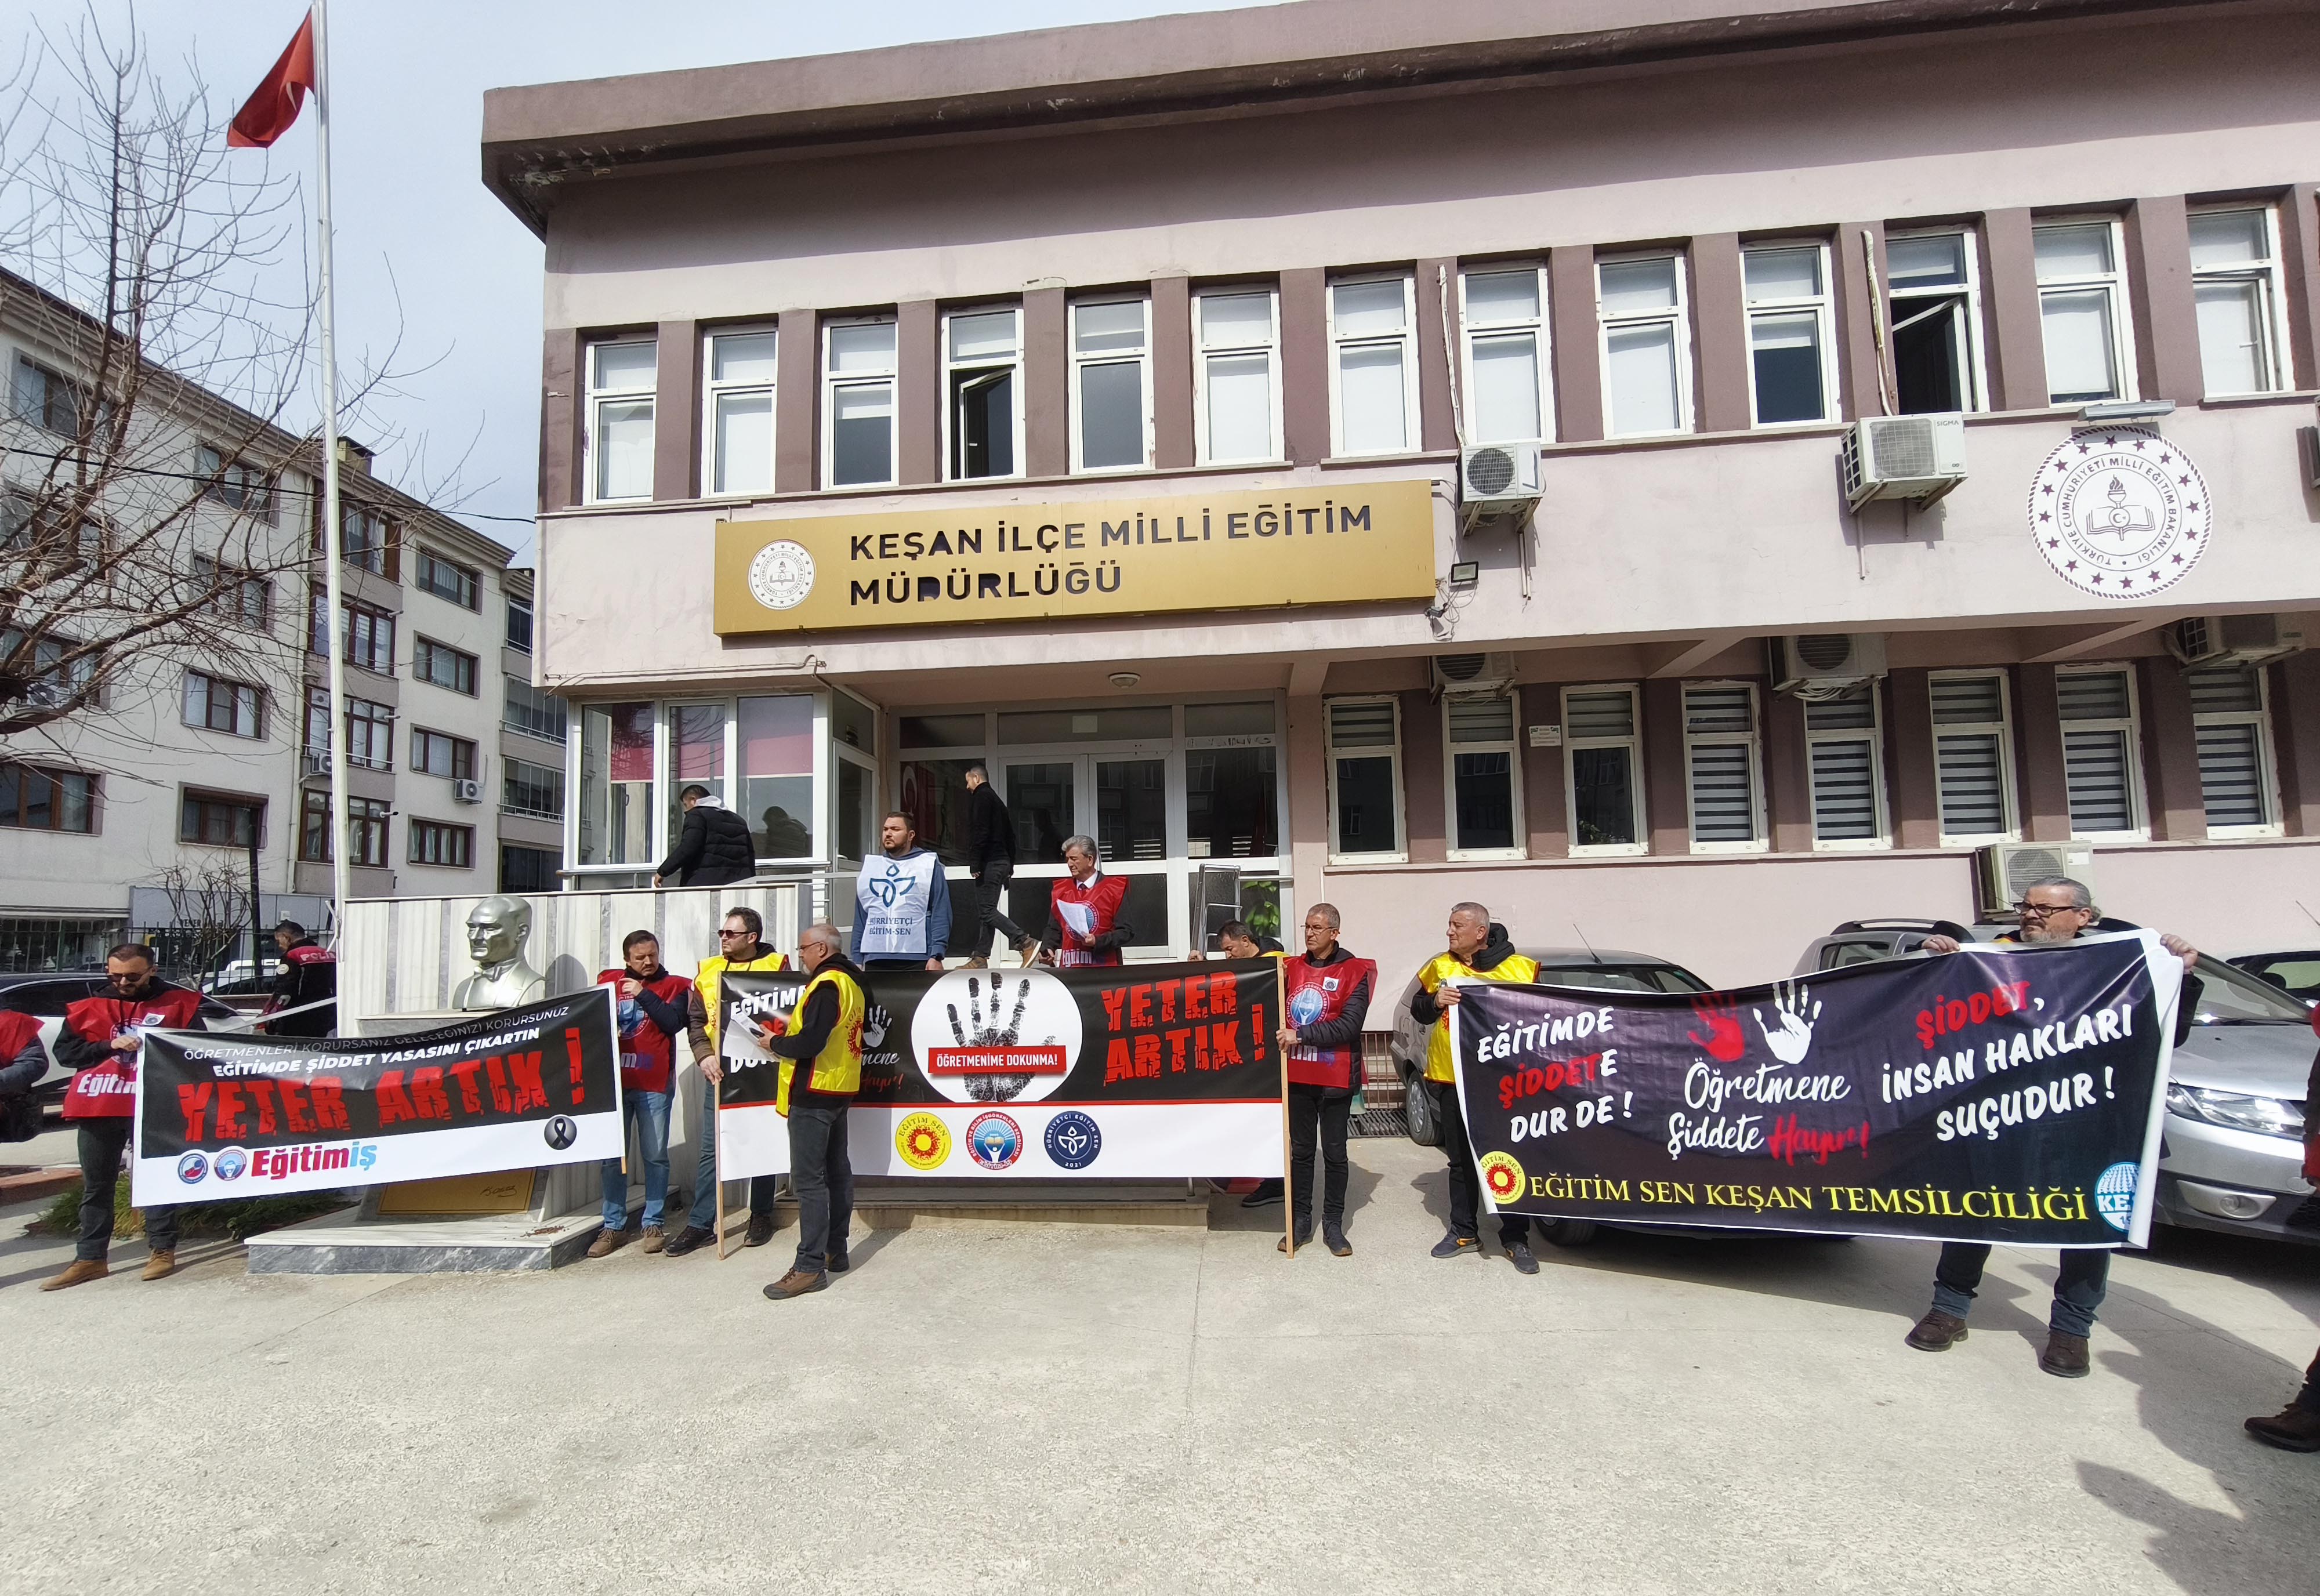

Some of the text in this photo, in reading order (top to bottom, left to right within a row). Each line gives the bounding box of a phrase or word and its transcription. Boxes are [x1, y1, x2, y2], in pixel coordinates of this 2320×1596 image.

[850, 500, 1372, 561] KEŞAN İLÇE MİLLİ EĞİTİM
[2061, 456, 2177, 565] TÜRKİYE CUMHURİYETİ MİLLİ EĞİTİM BAKANLIĞI
[850, 558, 1122, 607] MÜDÜRLÜĞÜ
[869, 917, 913, 927] HÜRRİYETÇİ
[869, 926, 911, 935] EĞİTİM-SEN
[1101, 970, 1238, 1032] YETER
[184, 1041, 298, 1061] ÖĞRETMENLERİ
[485, 1005, 570, 1031] KORURSUNUZ
[212, 1026, 540, 1078] EĞİTİMDE ŞİDDET YASASINI ÇIKARTIN
[1103, 1020, 1244, 1087] ARTIK
[1477, 1006, 1615, 1063] EĞİTİMDE
[1882, 1003, 2133, 1104] İNSAN HAKLARI
[936, 1053, 1058, 1068] ÖĞRETMENİME DOKUNMA!
[1498, 1049, 1618, 1109] ŞİDDETE
[1684, 1057, 1851, 1113] Öğretmene
[177, 1075, 351, 1142] YETER
[375, 1050, 550, 1129] ARTIK
[1510, 1090, 1634, 1143] DUR DE !
[1936, 1065, 2116, 1141] SUÇUDUR !
[898, 1115, 948, 1137] EĞİTİM SEN
[1667, 1112, 1765, 1160] Şiddete
[1481, 1154, 1505, 1168] ĞİTİM
[1528, 1171, 1632, 1202] EĞİTİM
[1639, 1180, 1697, 1205] SEN
[1703, 1184, 1812, 1213] KEŞAN
[1821, 1183, 2090, 1221] TEMSİLCİLİĞİ
[2097, 1194, 2136, 1212] KE
